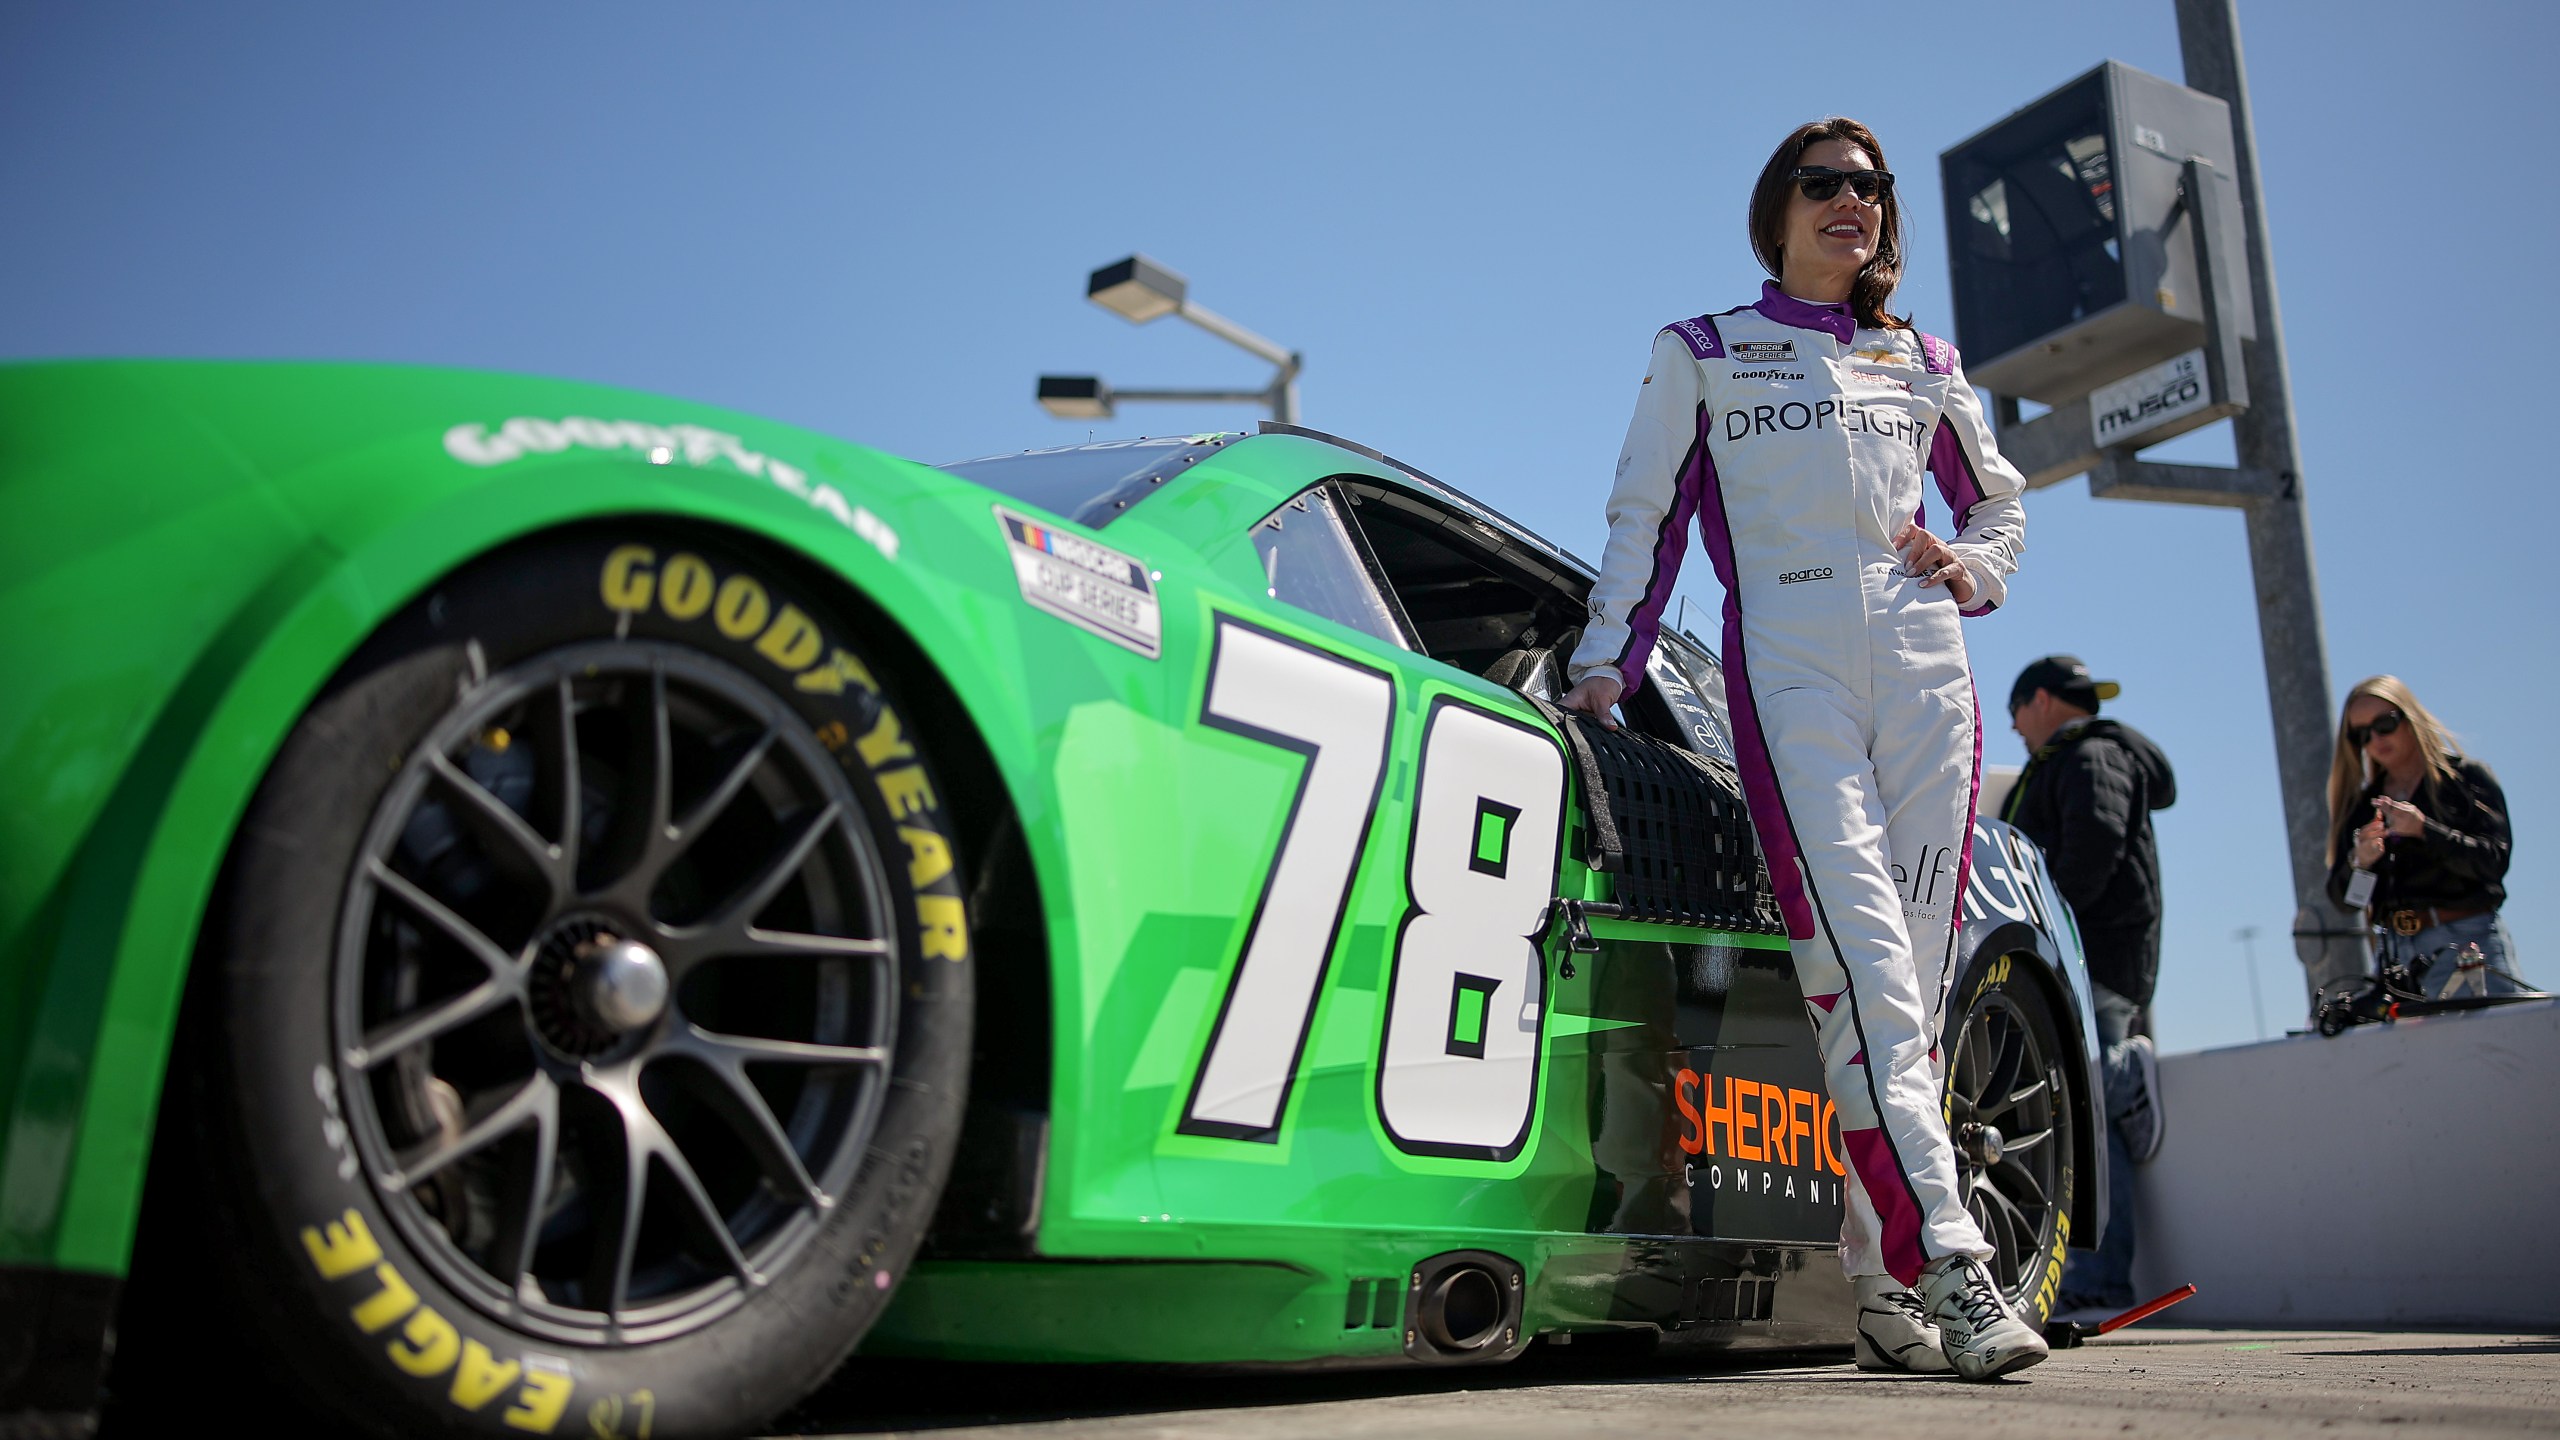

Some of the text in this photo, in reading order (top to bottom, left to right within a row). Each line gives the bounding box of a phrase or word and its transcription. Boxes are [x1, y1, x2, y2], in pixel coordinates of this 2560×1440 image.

[1725, 400, 1928, 450] DROPLIGHT
[1038, 560, 1139, 626] CUP SERIES
[1052, 535, 1133, 586] NASCAR
[1779, 567, 1833, 584] sparco
[601, 544, 968, 962] GOODYEAR
[1175, 608, 1568, 1162] 78
[1903, 909, 1938, 920] ps.face.
[1675, 1068, 1847, 1176] SHERFIC
[1685, 1162, 1837, 1206] COMPANI
[2034, 1208, 2071, 1324] EAGLE
[303, 1207, 576, 1433] EAGLE
